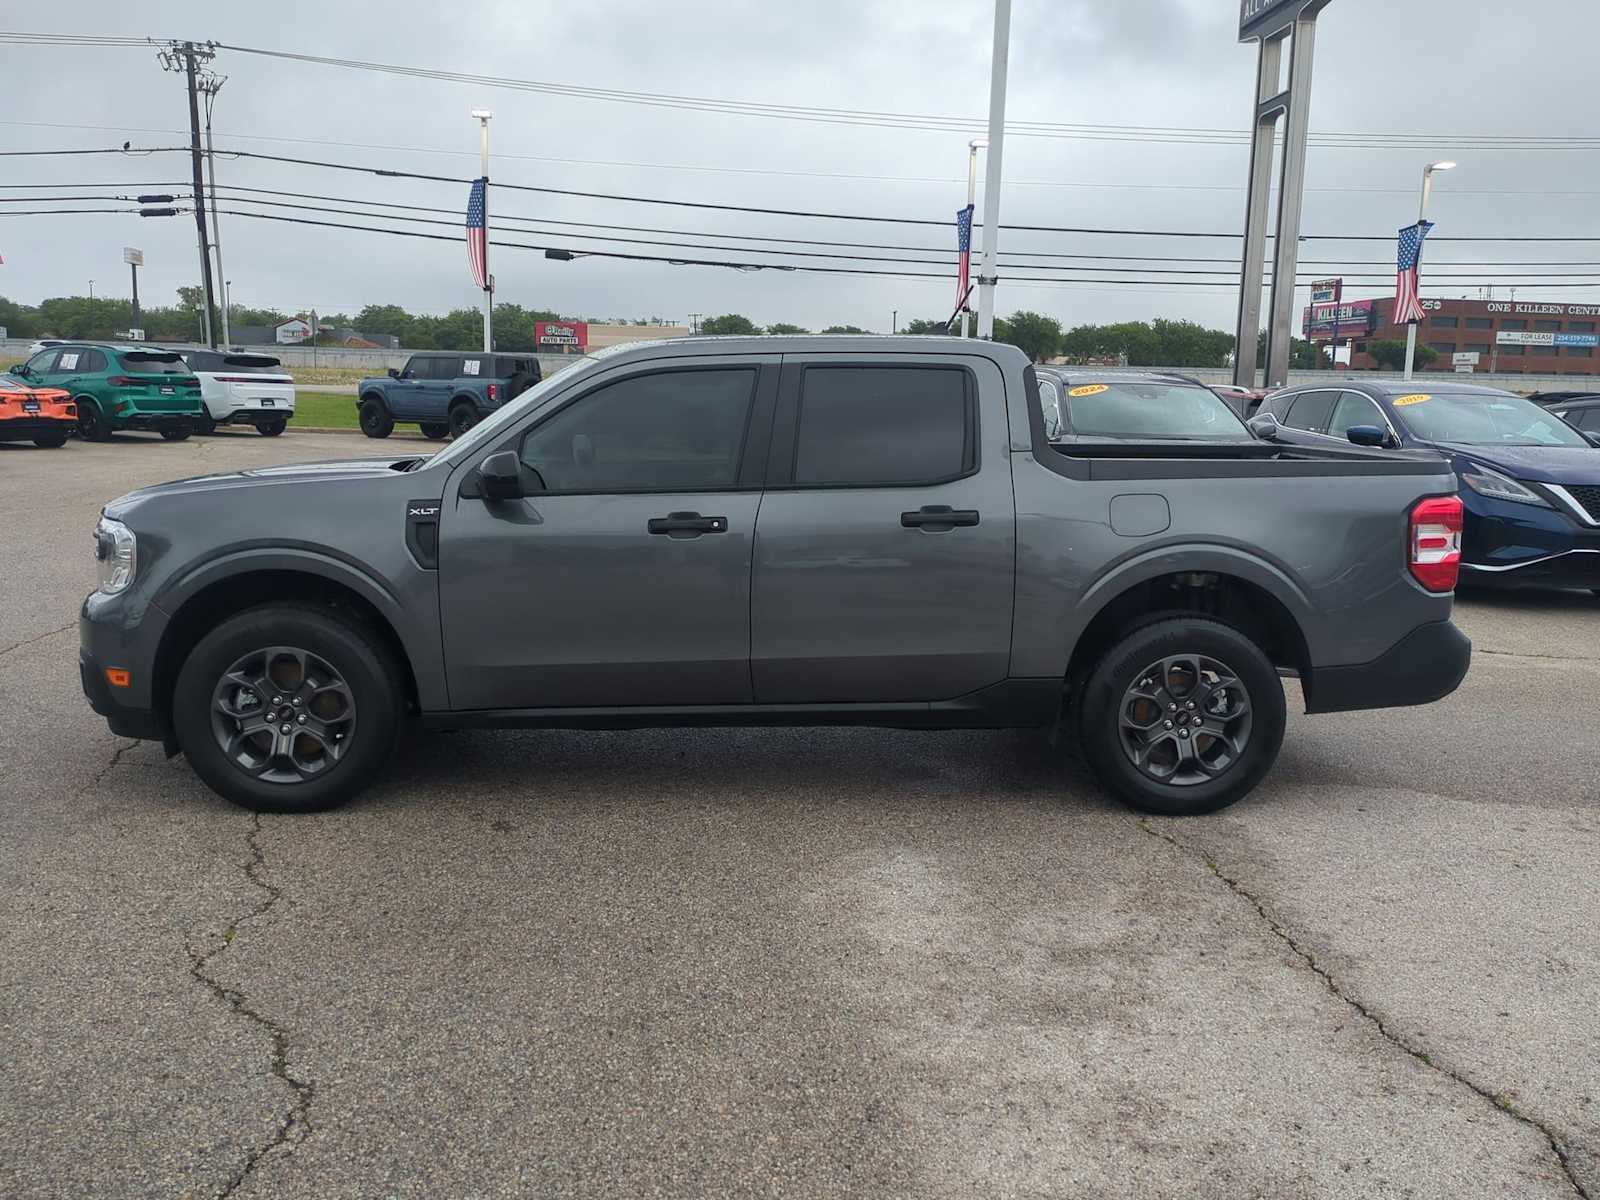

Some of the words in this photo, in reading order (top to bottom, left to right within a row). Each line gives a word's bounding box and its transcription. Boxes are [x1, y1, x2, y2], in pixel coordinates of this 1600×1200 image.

[1317, 306, 1353, 320] KILLEEN
[1487, 303, 1512, 313] ONE
[1515, 304, 1564, 314] KILLEEN
[1567, 306, 1600, 315] CENT
[1073, 386, 1104, 395] 2024
